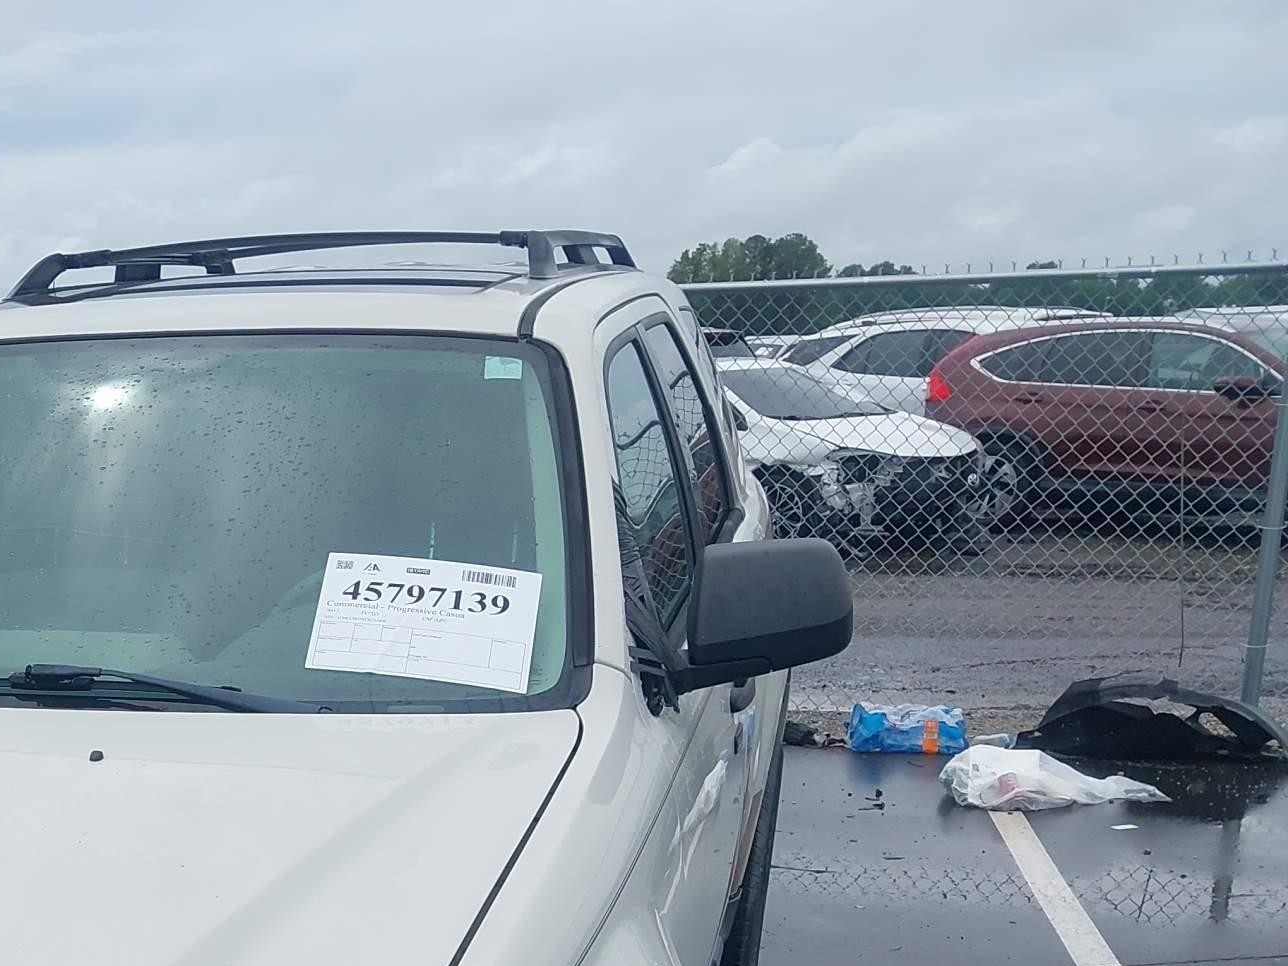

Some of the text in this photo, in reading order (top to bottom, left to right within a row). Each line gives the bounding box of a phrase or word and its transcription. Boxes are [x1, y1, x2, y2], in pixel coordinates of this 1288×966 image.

[326, 599, 379, 610] Commercial
[387, 604, 437, 615] Progressive
[342, 580, 510, 615] 45797139
